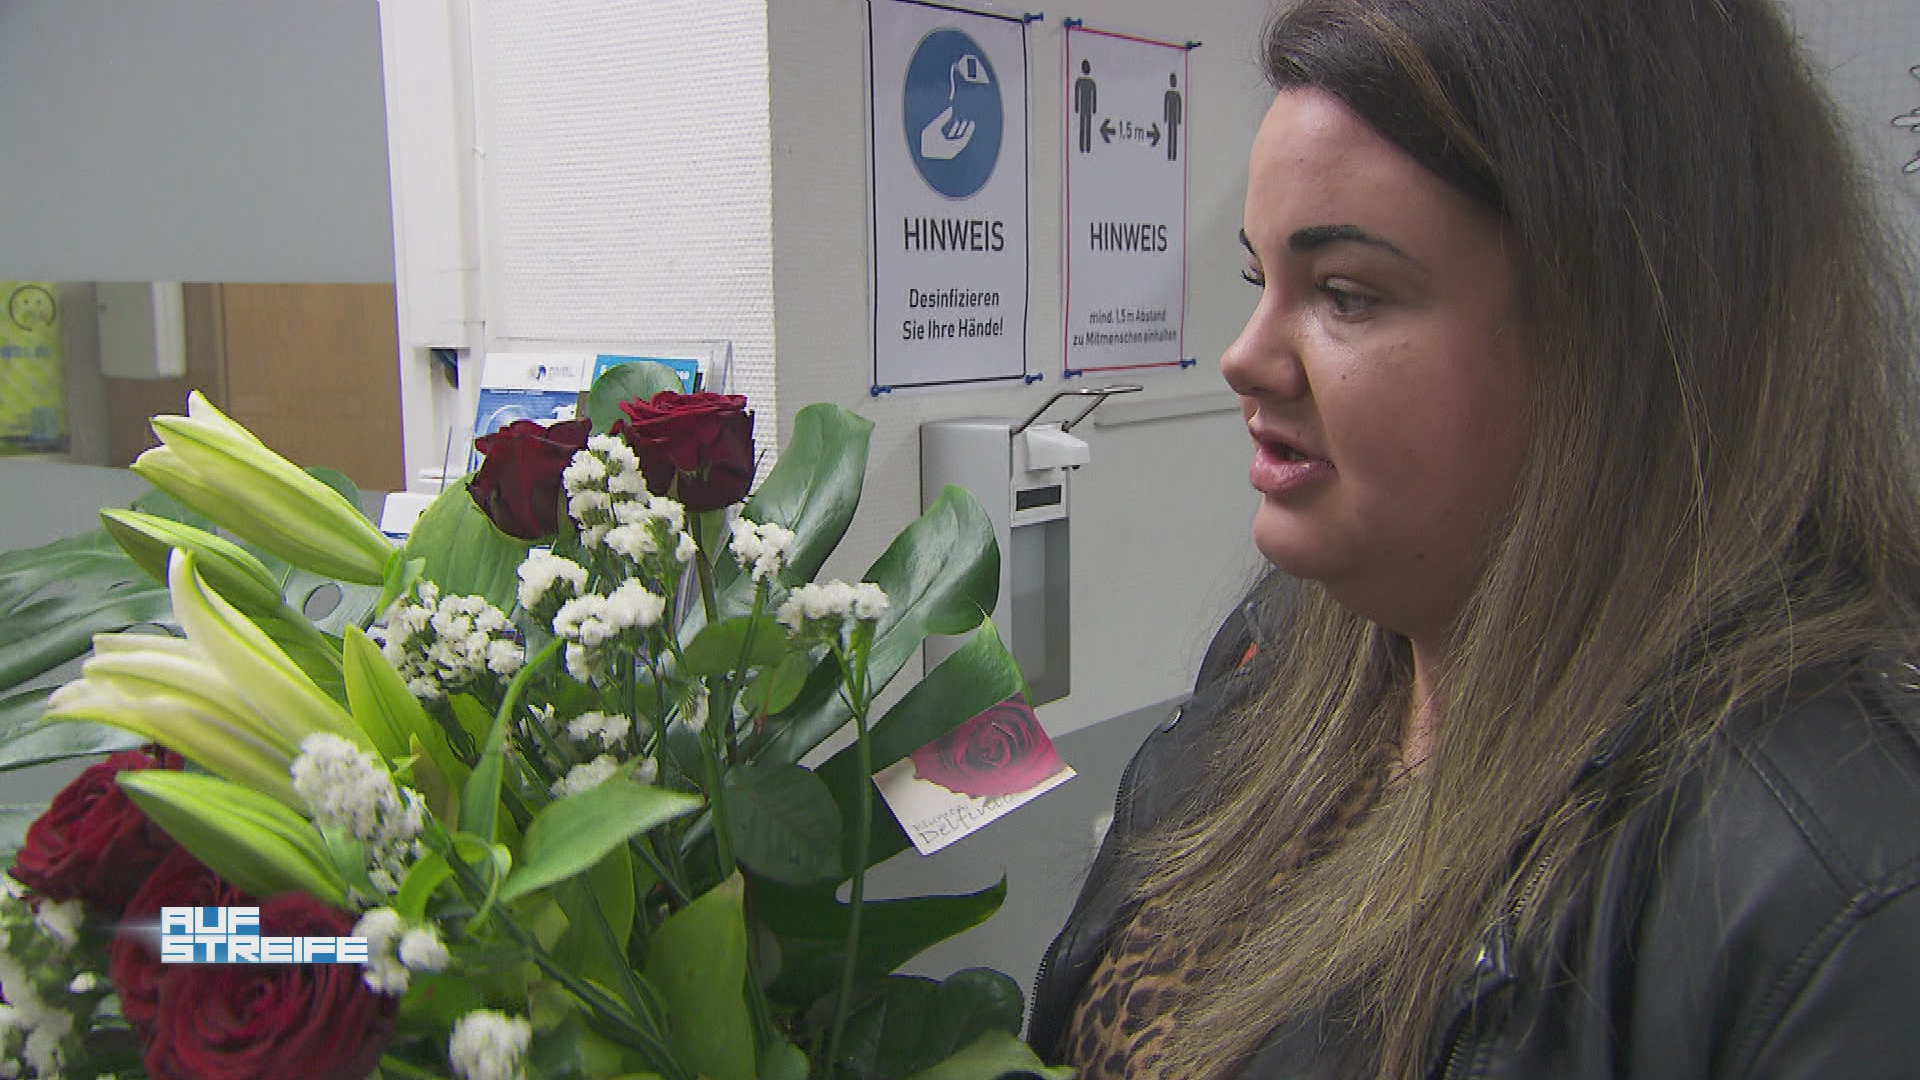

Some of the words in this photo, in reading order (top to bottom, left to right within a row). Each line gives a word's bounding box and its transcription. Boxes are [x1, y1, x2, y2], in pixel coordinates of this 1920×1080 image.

[1134, 128, 1145, 140] m
[904, 217, 1005, 252] HINWEIS
[1090, 222, 1168, 252] HINWEIS
[909, 288, 1000, 308] Desinfizieren
[1089, 309, 1114, 324] mind.
[1135, 307, 1167, 322] Abstand
[902, 321, 925, 341] Sie
[928, 319, 955, 339] Ihre
[958, 317, 1004, 338] Hände!
[1073, 335, 1084, 345] zu
[1085, 331, 1142, 345] Mitmenschen
[1144, 329, 1177, 342] einhalten
